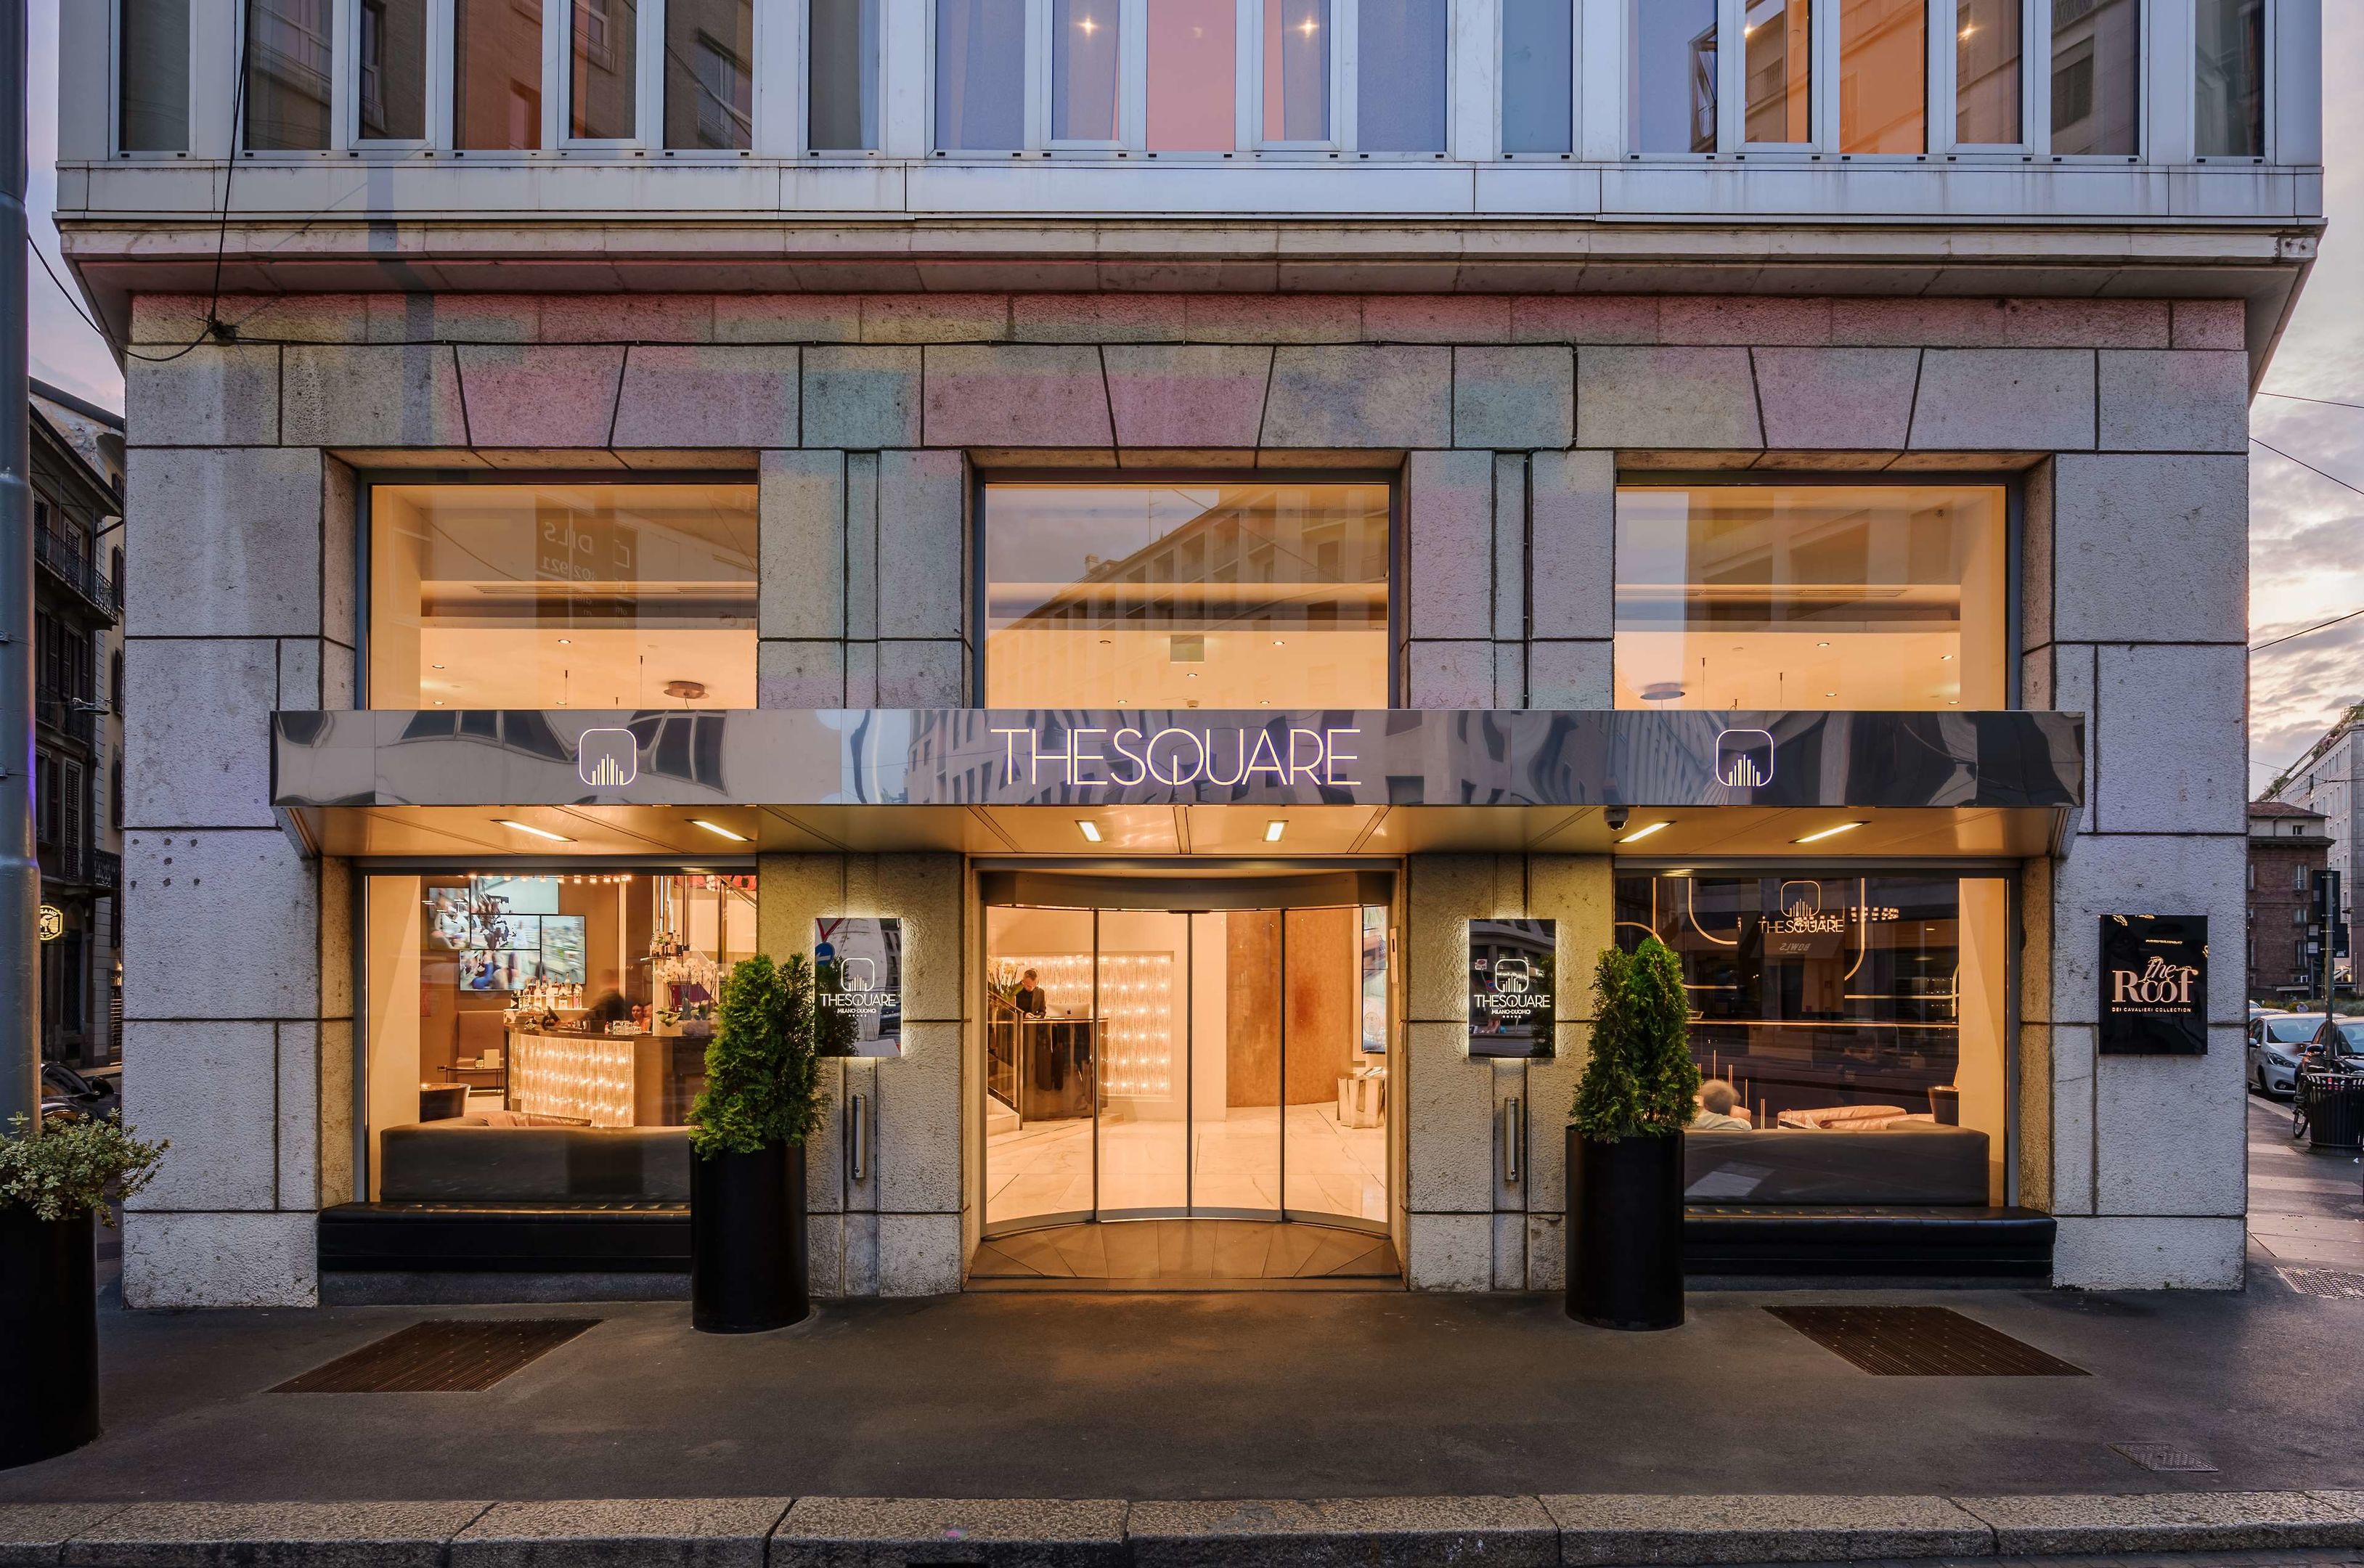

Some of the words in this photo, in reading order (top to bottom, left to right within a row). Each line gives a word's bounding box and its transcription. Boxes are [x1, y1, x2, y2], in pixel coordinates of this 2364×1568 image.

[990, 728, 1361, 785] THESQUARE
[820, 993, 897, 1007] THESQUARE
[1474, 995, 1551, 1008] THESQUARE
